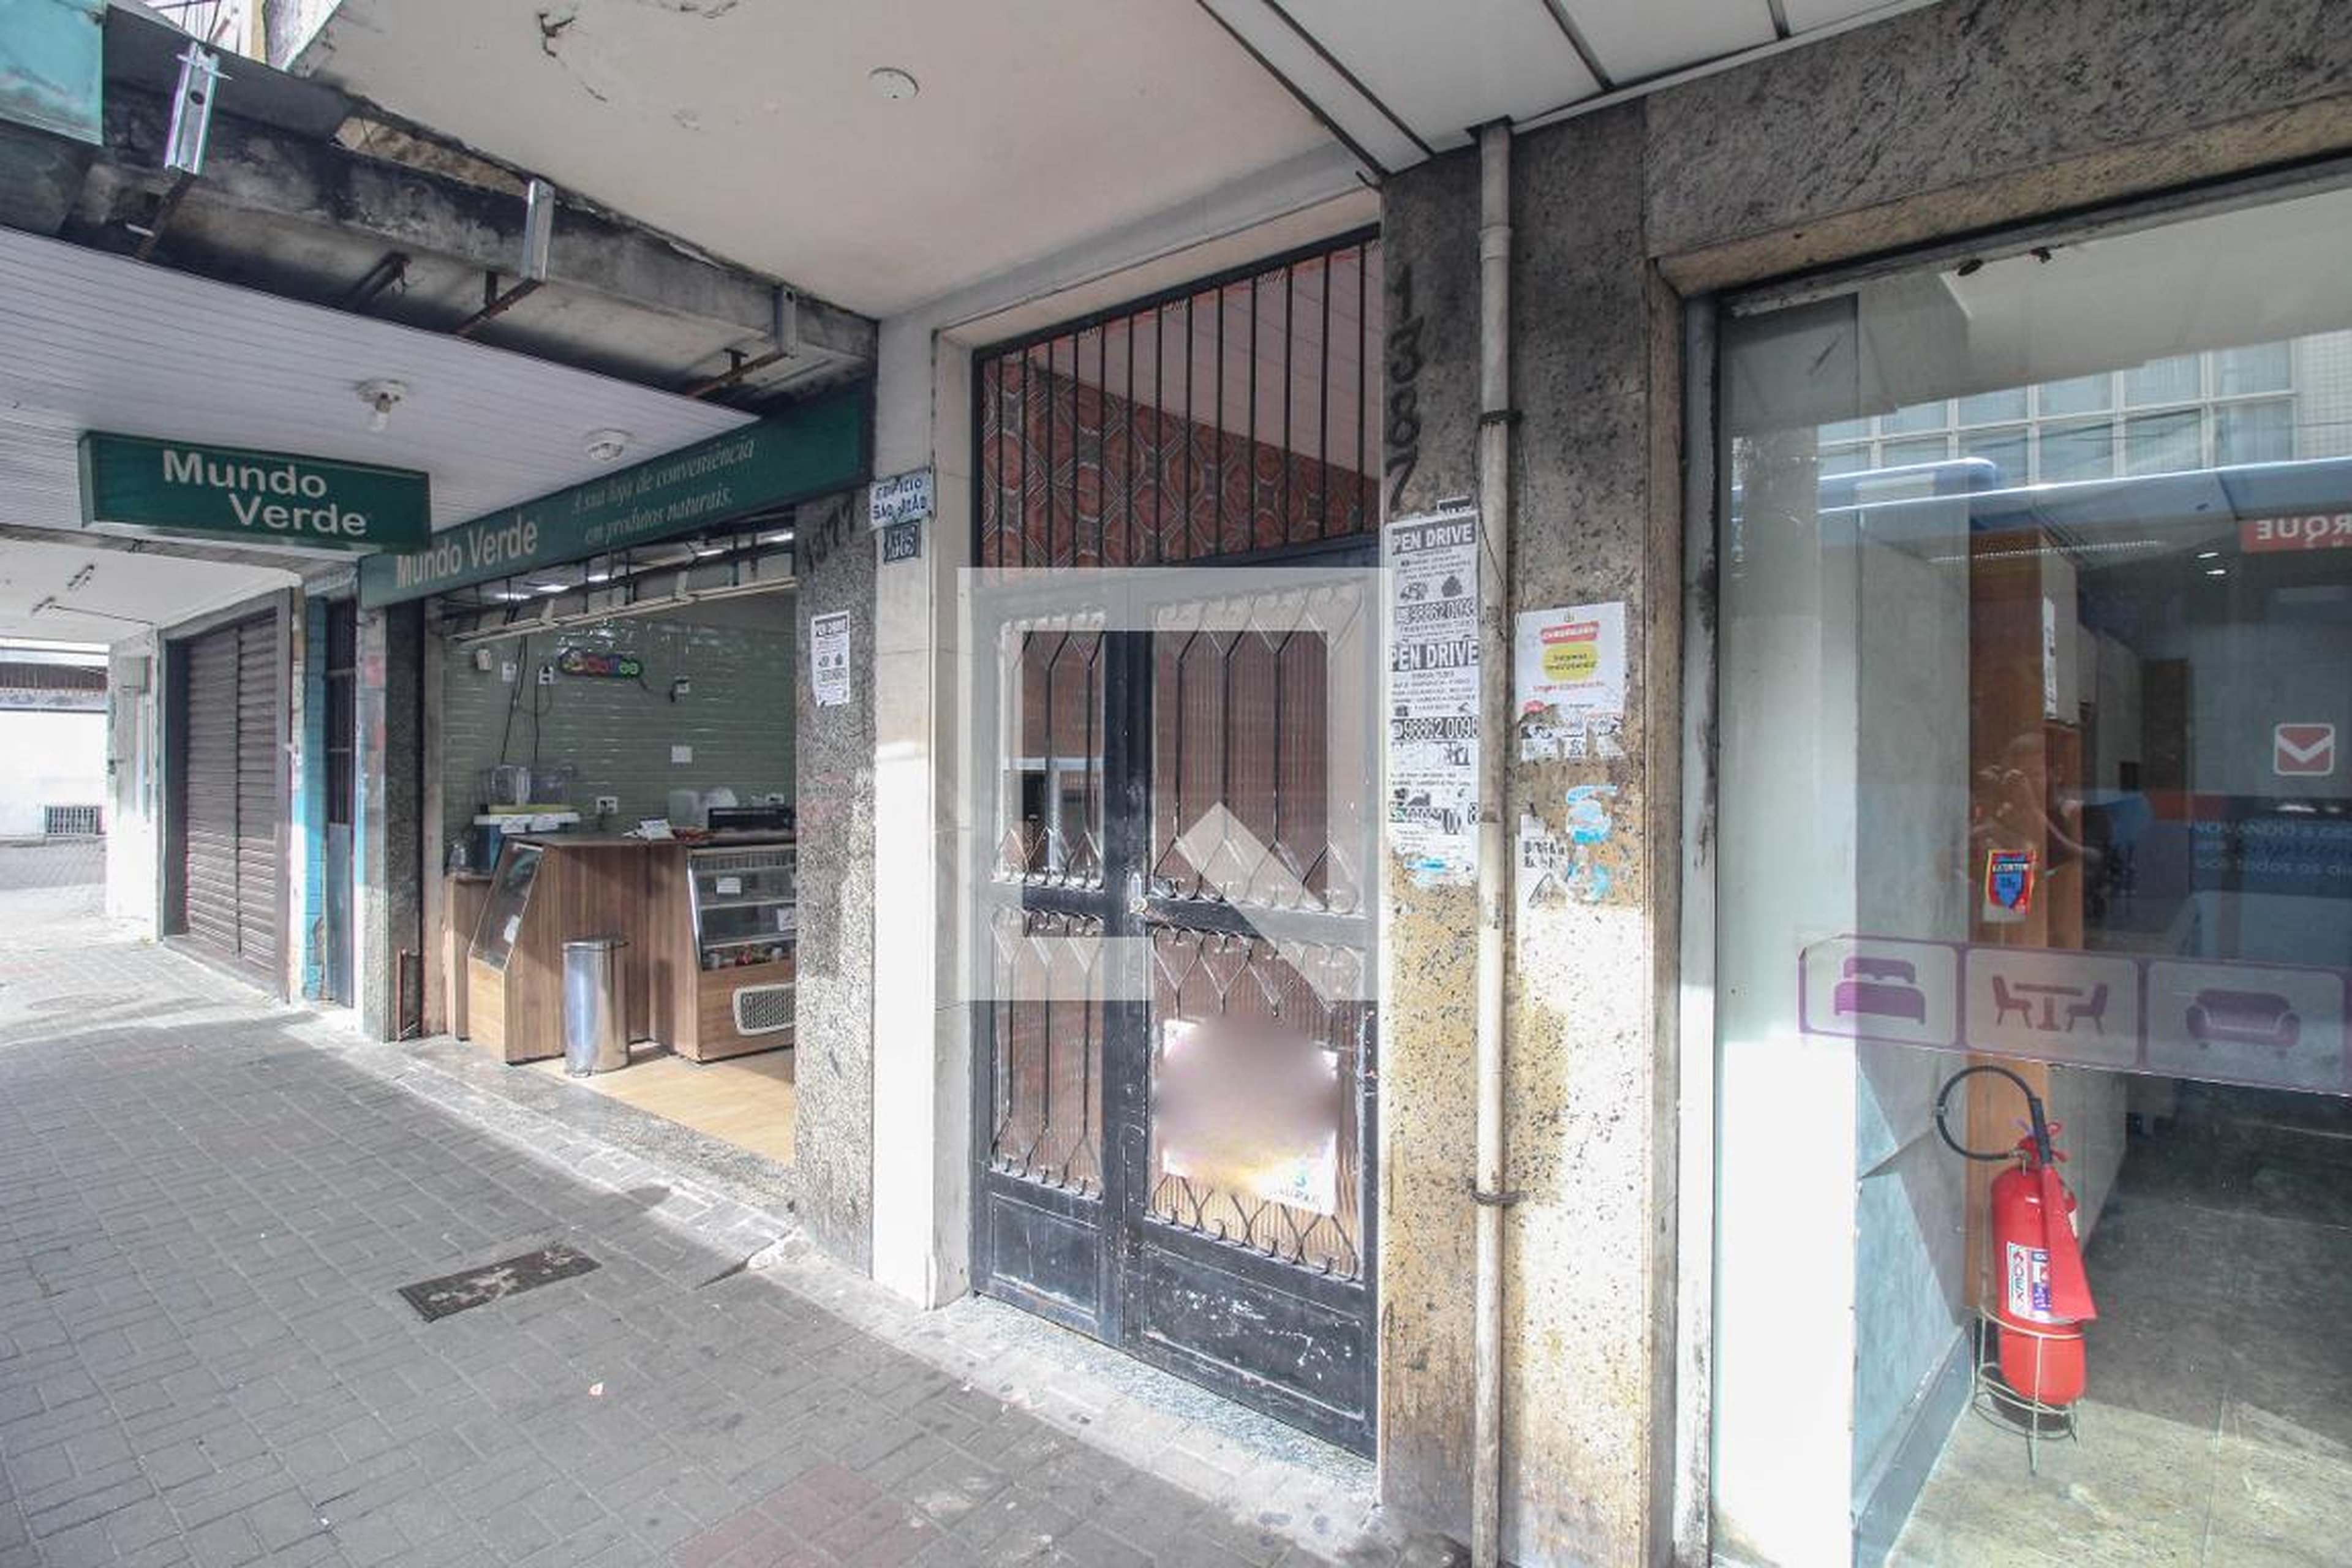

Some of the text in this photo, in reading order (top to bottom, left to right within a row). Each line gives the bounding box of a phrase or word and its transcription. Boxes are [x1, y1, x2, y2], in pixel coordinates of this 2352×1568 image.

[164, 450, 327, 499] Mundo
[228, 493, 368, 537] Verde
[1392, 523, 1473, 551] PEN DRIVE
[396, 513, 538, 589] Mundo Verde
[1389, 641, 1479, 671] PEN DRIVE
